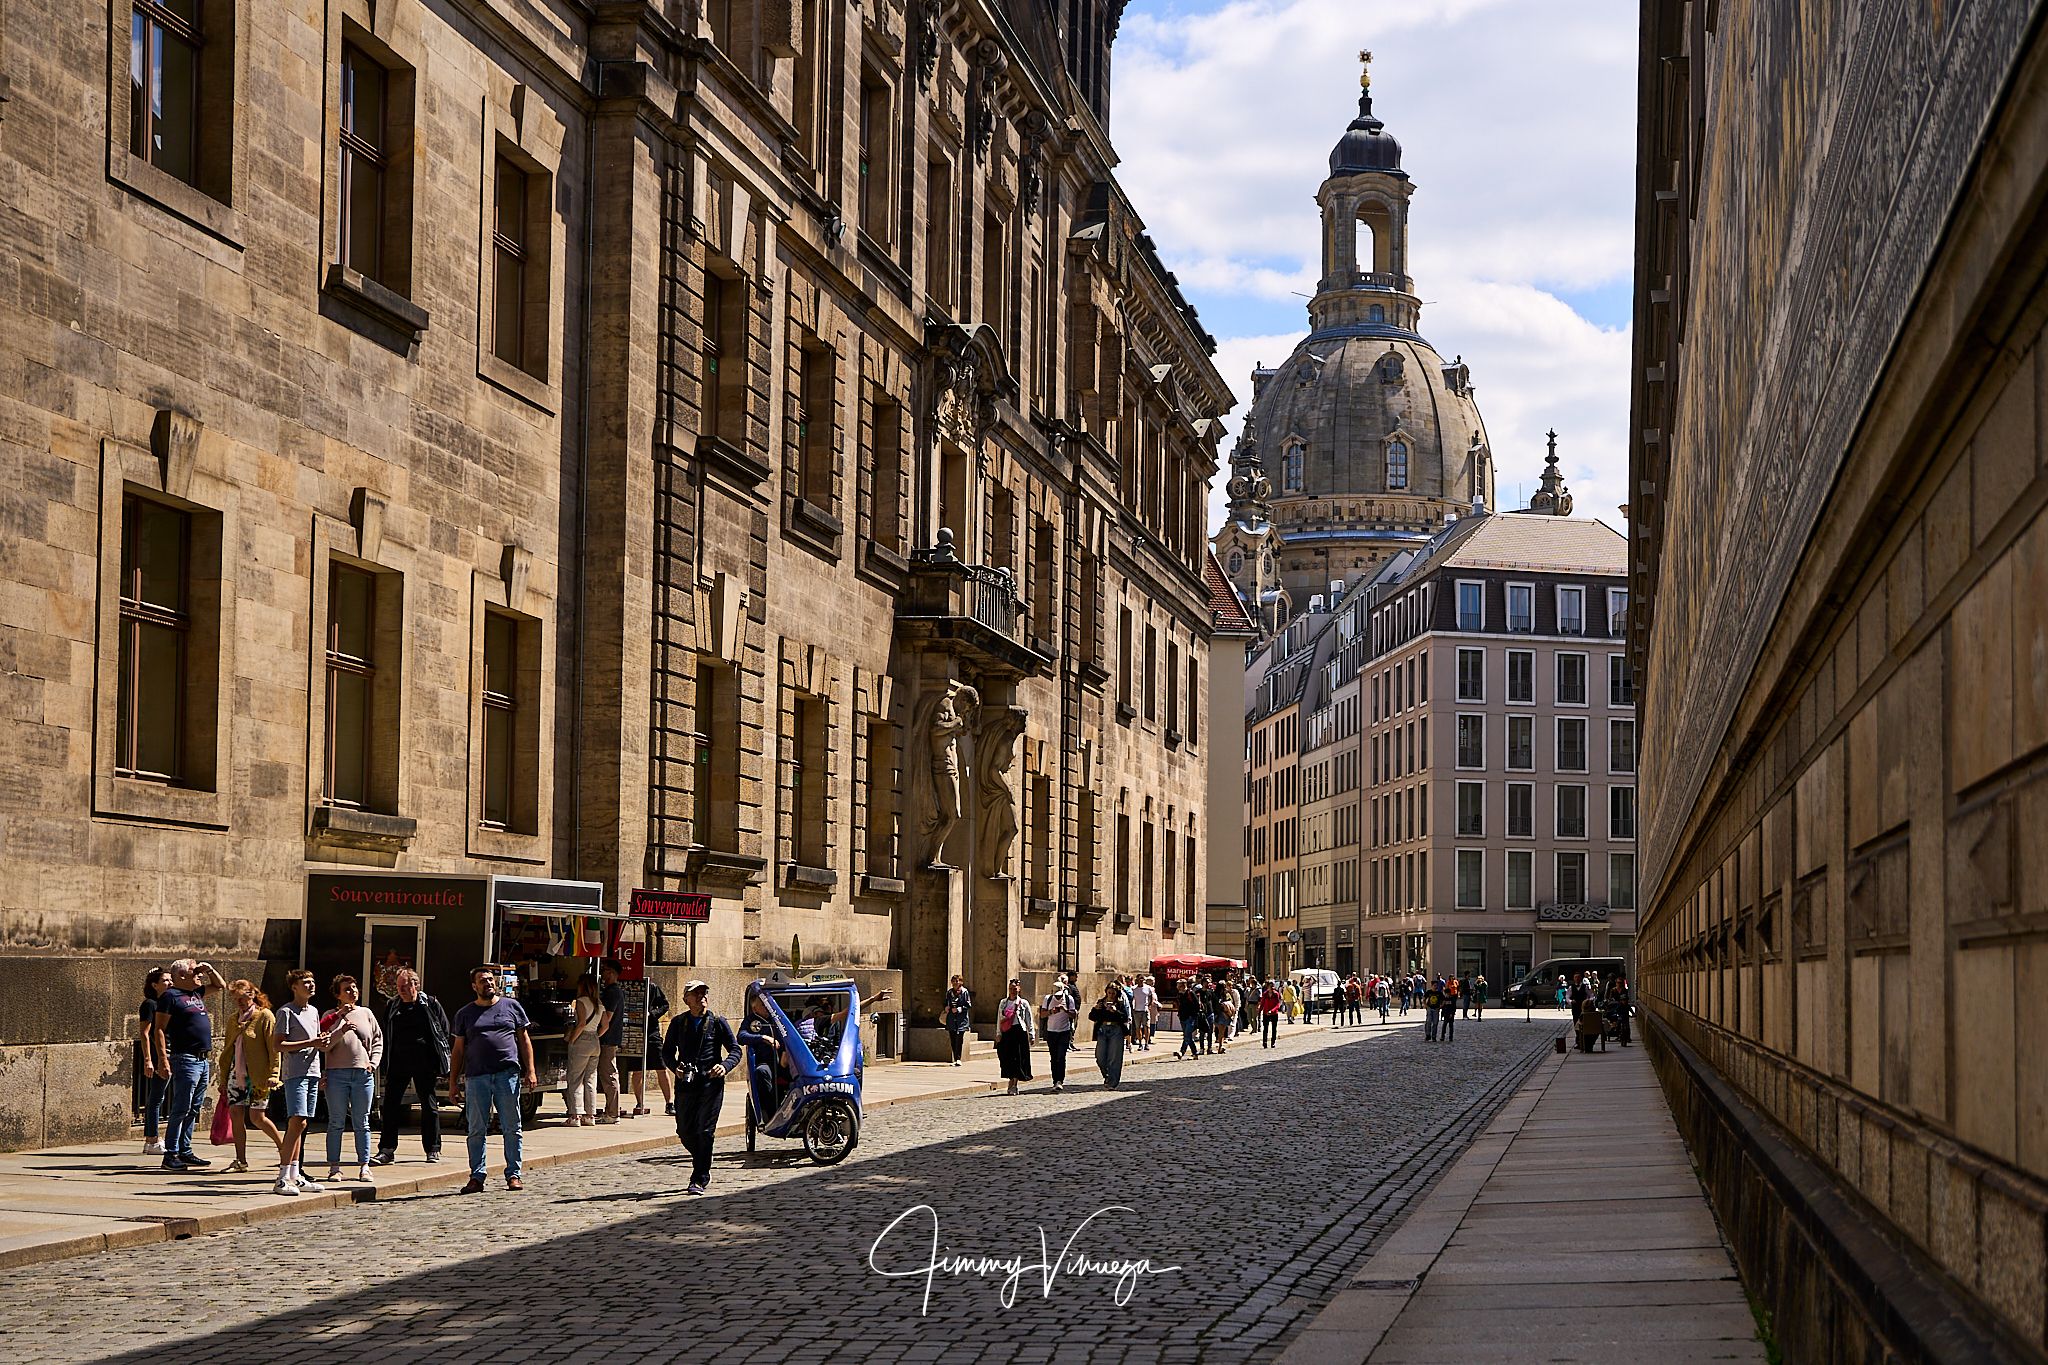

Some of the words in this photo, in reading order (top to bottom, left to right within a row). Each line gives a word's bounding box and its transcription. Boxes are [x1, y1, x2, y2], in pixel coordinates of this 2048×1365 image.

[329, 884, 465, 907] Souveniroutlet
[634, 894, 707, 916] Souveniroutlet
[771, 971, 779, 983] 4
